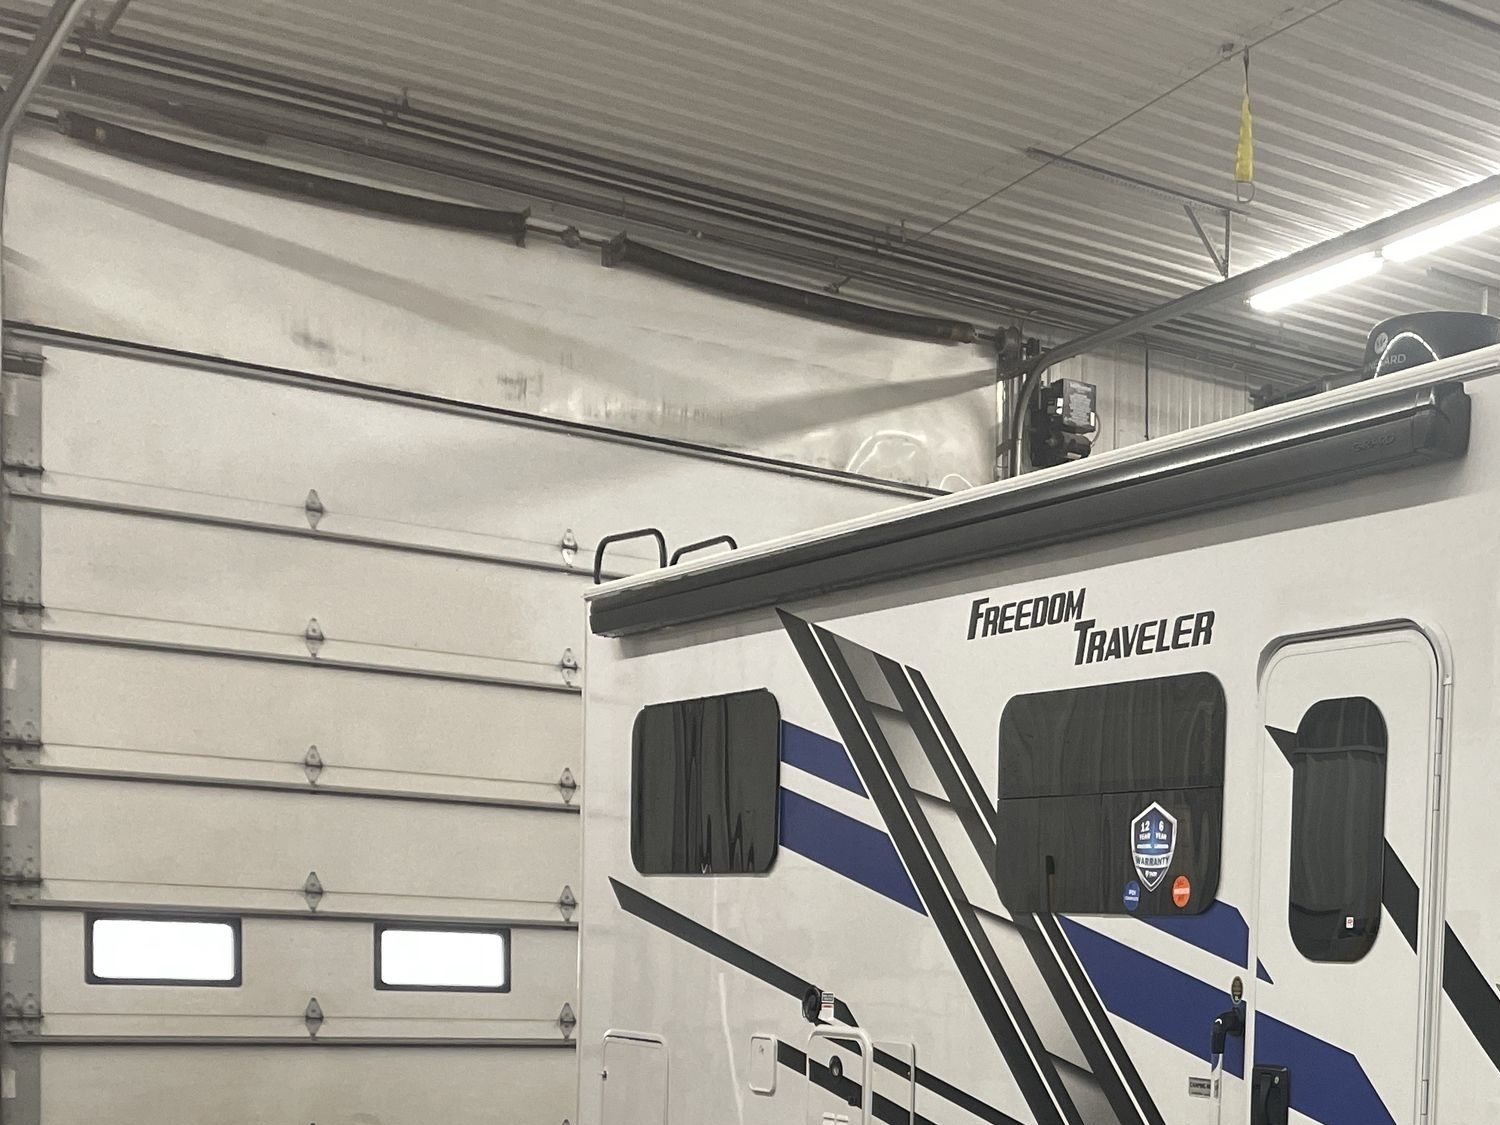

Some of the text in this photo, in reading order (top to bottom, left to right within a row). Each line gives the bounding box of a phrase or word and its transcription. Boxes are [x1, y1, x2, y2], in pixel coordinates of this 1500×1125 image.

[967, 588, 1086, 640] FREEDOM
[1074, 610, 1215, 666] TRAVELER
[1141, 820, 1150, 832] 12
[1158, 821, 1164, 831] 6
[1136, 856, 1169, 866] WARRANTY
